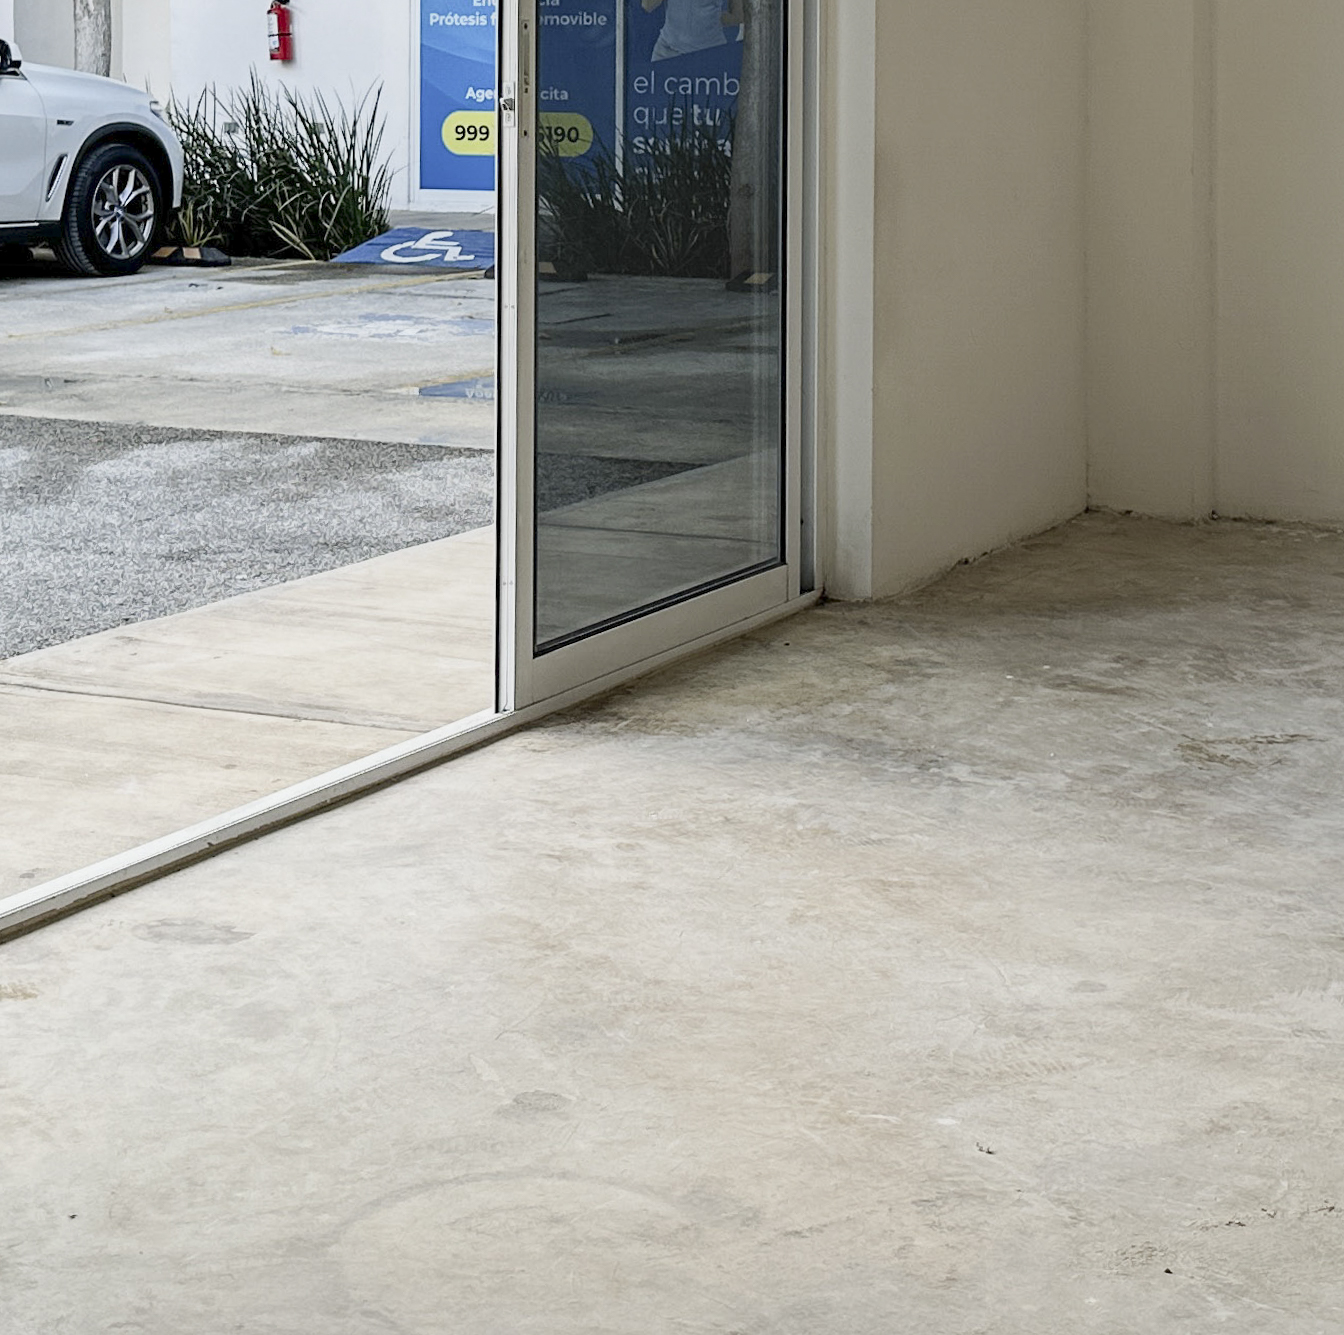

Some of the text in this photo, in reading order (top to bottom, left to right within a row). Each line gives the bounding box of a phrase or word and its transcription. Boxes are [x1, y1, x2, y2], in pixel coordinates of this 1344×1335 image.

[429, 12, 488, 27] Prótesis
[633, 70, 741, 96] el camb
[540, 87, 569, 101] cita
[633, 106, 684, 131] que
[455, 125, 490, 141] 999
